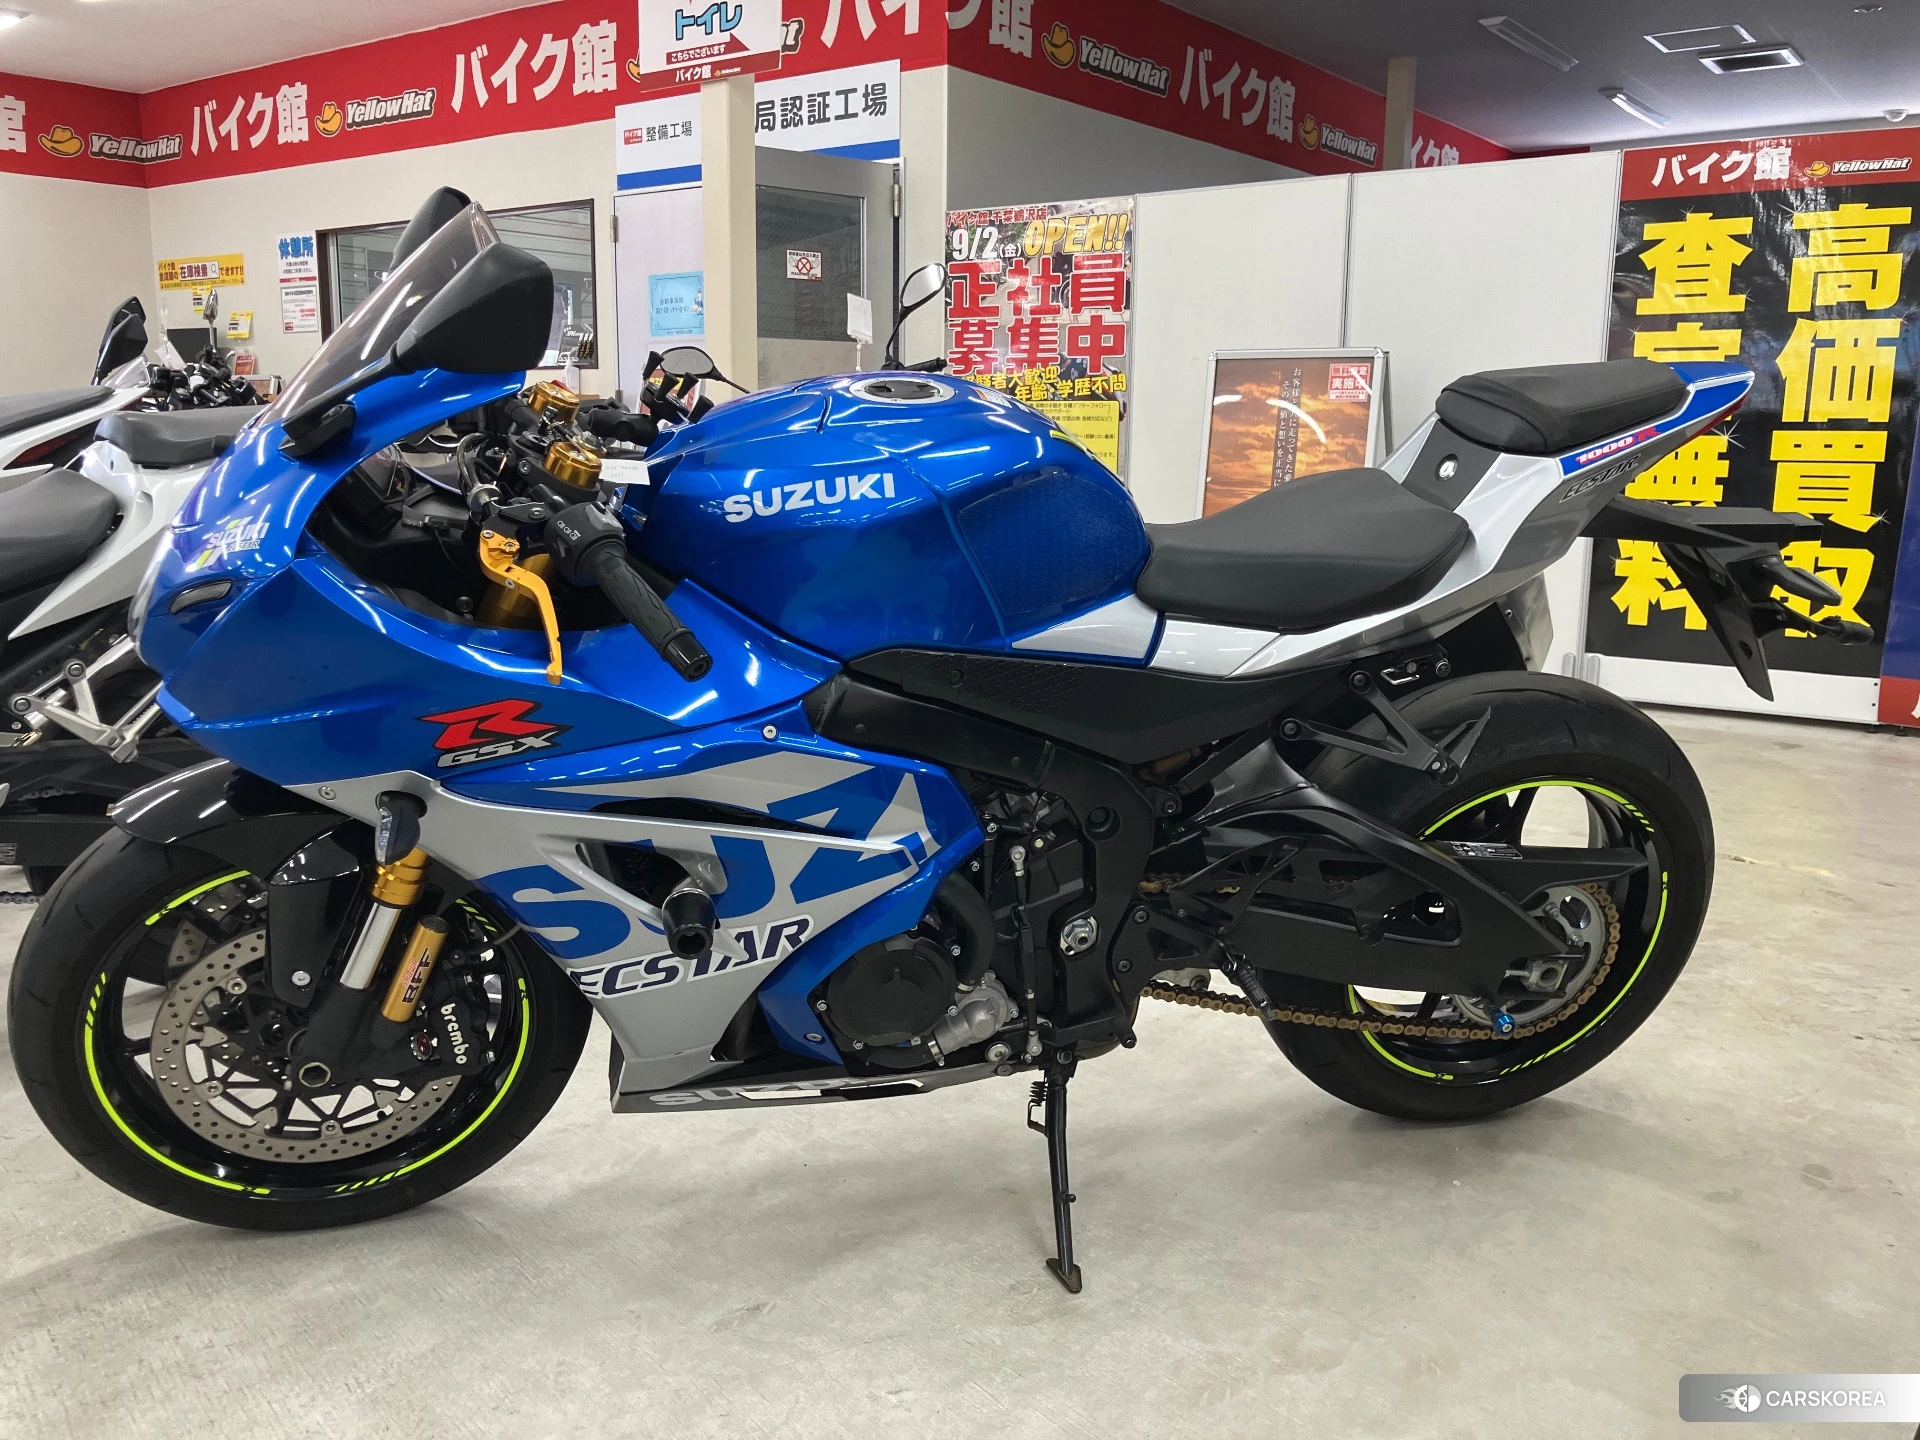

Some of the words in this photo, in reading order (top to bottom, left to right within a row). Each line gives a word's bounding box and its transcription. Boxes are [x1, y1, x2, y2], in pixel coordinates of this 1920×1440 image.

[675, 1, 743, 41] トイレ
[451, 20, 617, 113] バイク館
[671, 44, 726, 62] こちらでございます
[675, 65, 711, 82] バイク館
[1081, 37, 1169, 97] YellowHat
[346, 88, 435, 129] YellowHat
[755, 82, 888, 134] 局認証工場
[1180, 45, 1296, 143] バイク館
[191, 82, 309, 157] バイク館
[646, 121, 692, 142] 整備工場
[90, 134, 182, 164] YellowHat
[1320, 124, 1378, 168] YellowHat
[1652, 147, 1791, 187] バイク館
[1832, 157, 1911, 175] YellowHat
[279, 236, 314, 259] 休憩所
[952, 226, 999, 261] 9/2
[1023, 214, 1129, 257] OPEN!!
[180, 264, 208, 279] 在庫検索
[947, 252, 1127, 320] 正社員
[947, 314, 1127, 376] 募集中
[724, 473, 895, 523] SUZUKI
[206, 522, 271, 549] SUZUKI
[420, 700, 557, 749] R
[437, 731, 559, 768] GSX
[402, 957, 419, 987] SHOWA
[402, 947, 432, 1004] BFF
[440, 1003, 470, 1065] brembo
